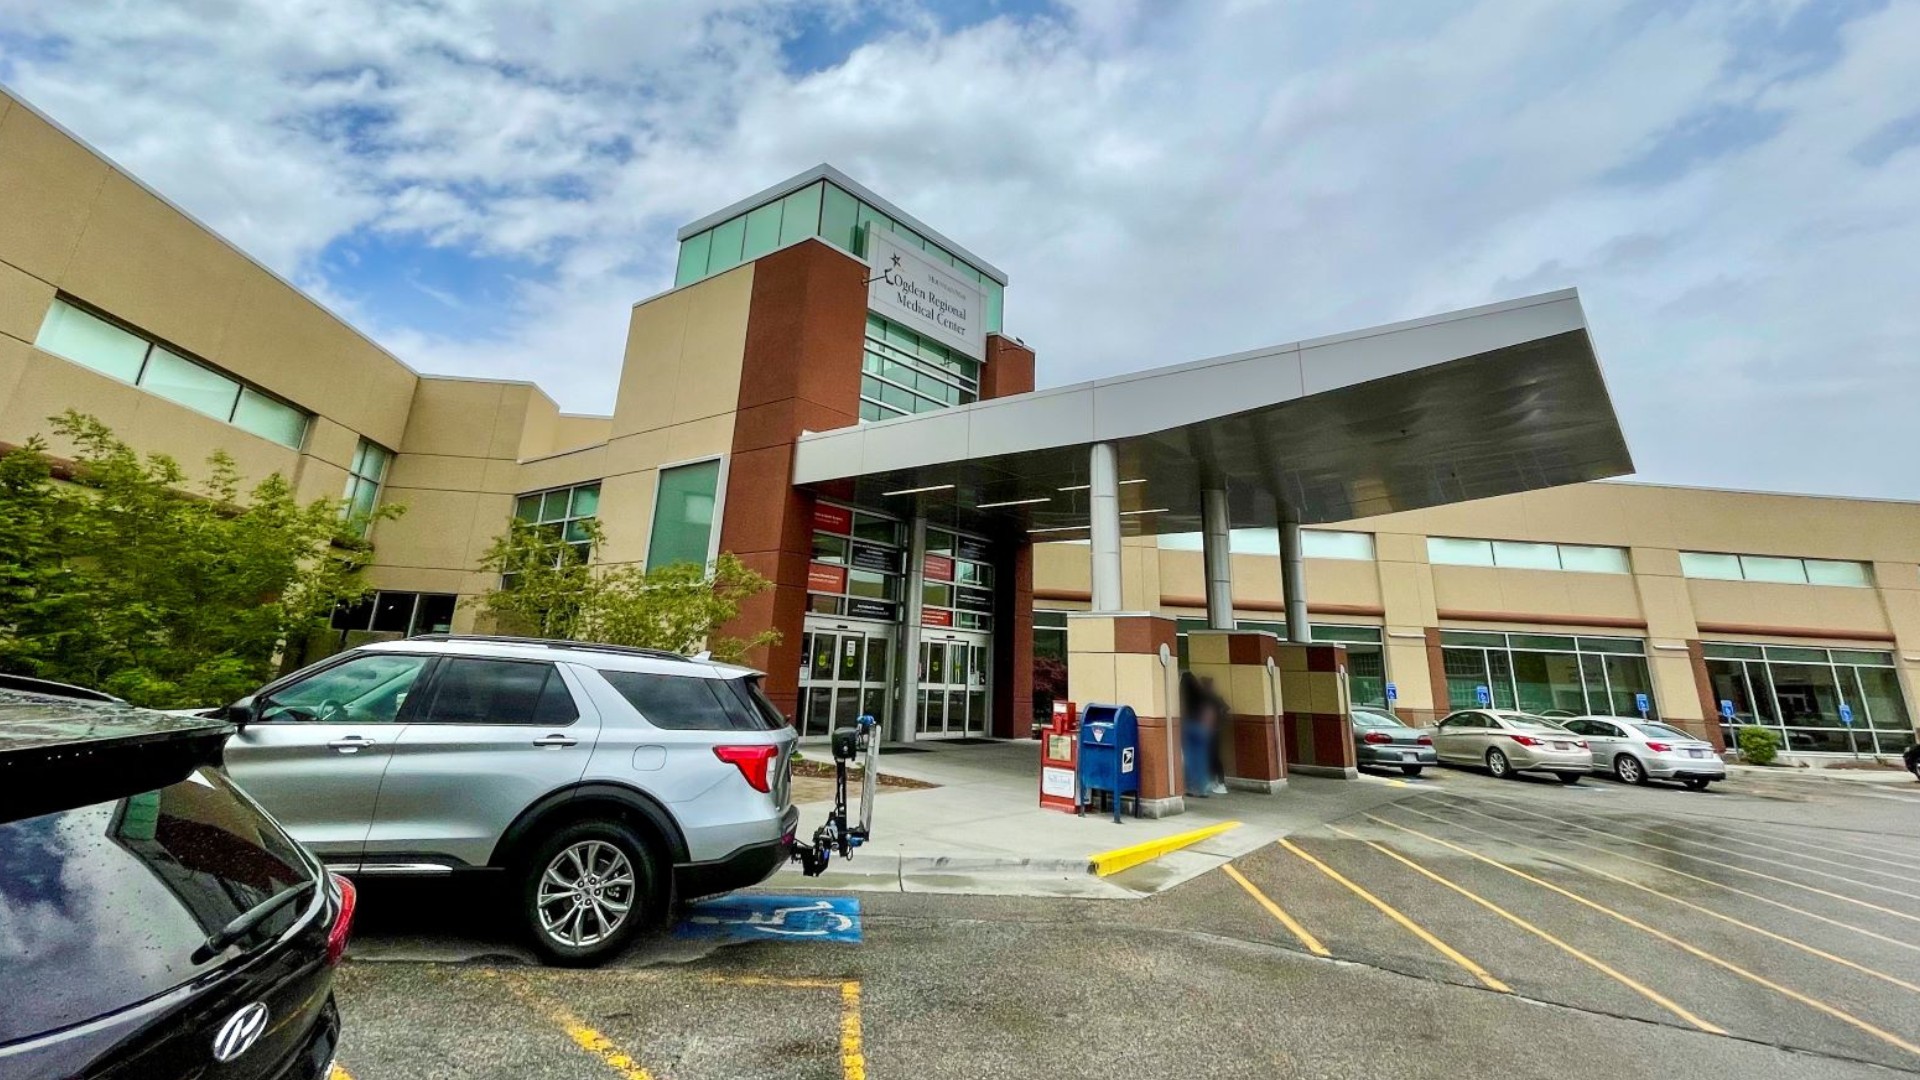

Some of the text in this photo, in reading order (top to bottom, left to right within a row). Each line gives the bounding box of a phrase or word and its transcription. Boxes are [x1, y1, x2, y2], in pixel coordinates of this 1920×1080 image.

[894, 274, 926, 299] Ogden
[929, 291, 966, 320] Regional
[897, 292, 966, 335] Medical Center
